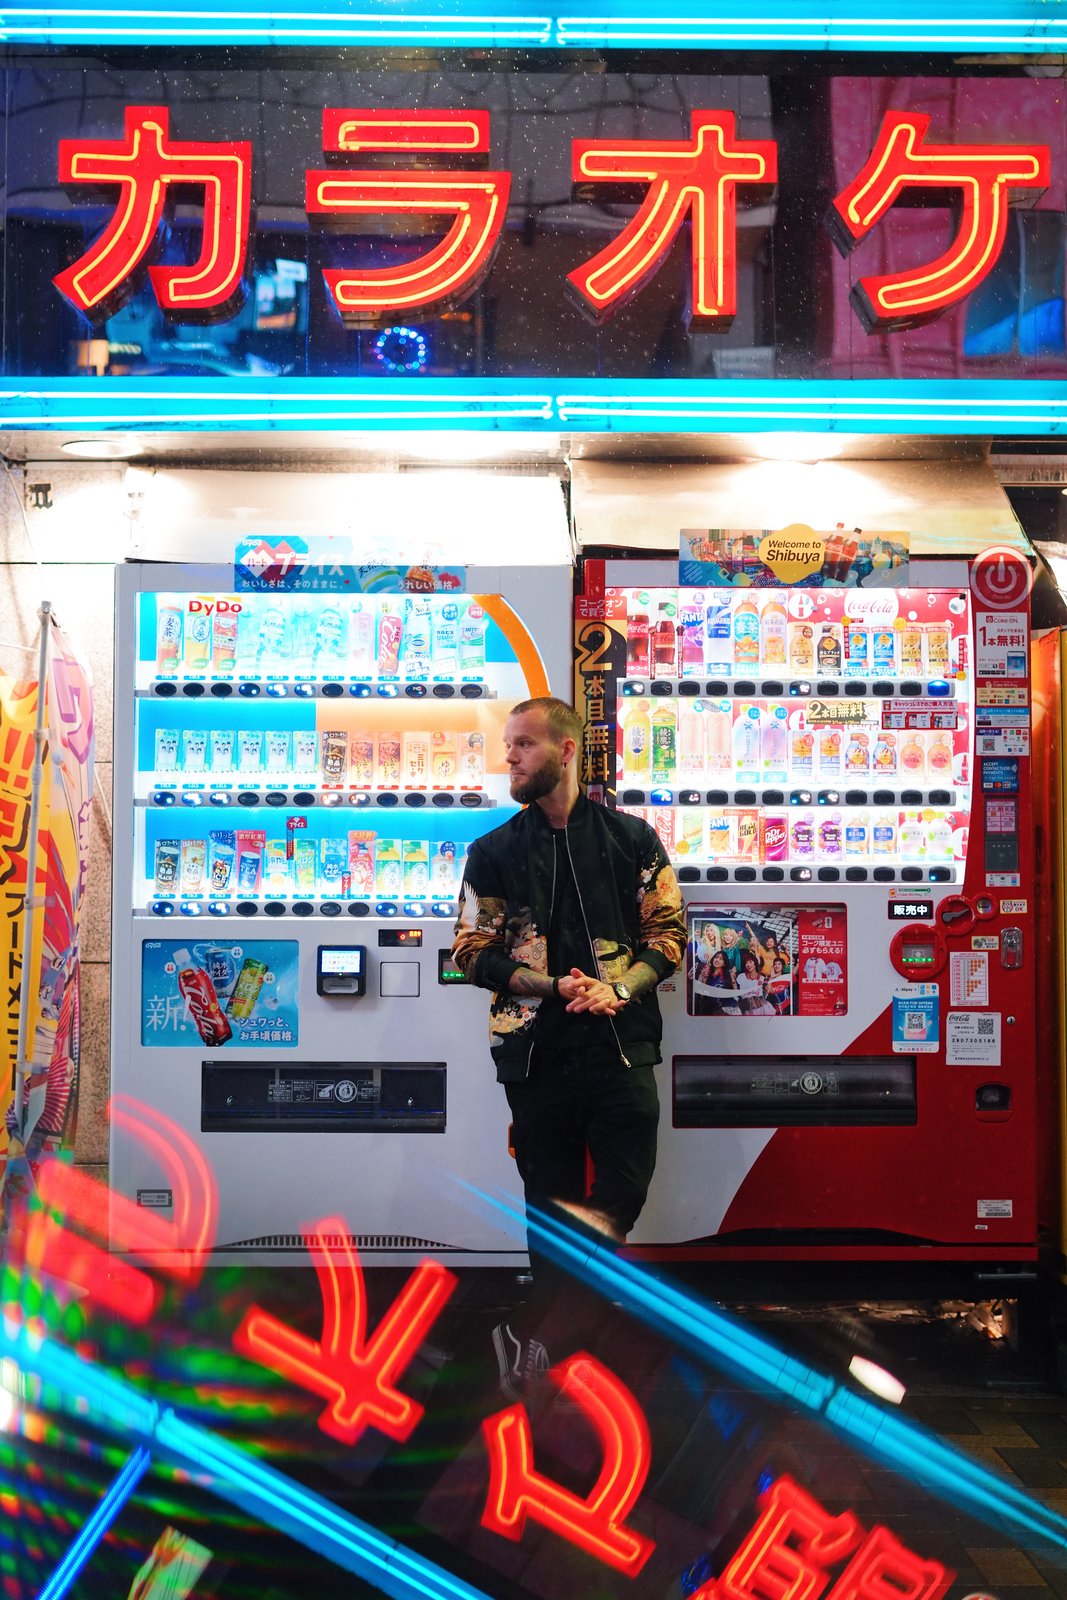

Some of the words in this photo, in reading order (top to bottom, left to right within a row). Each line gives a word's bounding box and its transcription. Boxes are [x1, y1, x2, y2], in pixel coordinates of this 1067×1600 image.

[53, 105, 1051, 320] カラオケ
[768, 540, 809, 549] Welcome
[811, 541, 821, 549] to
[766, 549, 820, 564] Shibuya
[189, 600, 242, 616] DyDo
[579, 599, 623, 609] コークオン
[848, 600, 893, 614] Coca-Cola
[979, 626, 1025, 647] 1本無料!
[809, 700, 864, 720] 2本目無料
[770, 828, 781, 836] Dr
[240, 864, 256, 874] TEA
[893, 904, 928, 916] 販売中
[240, 1018, 289, 1028] シュワっと、
[240, 1031, 297, 1042] お手頃価格。
